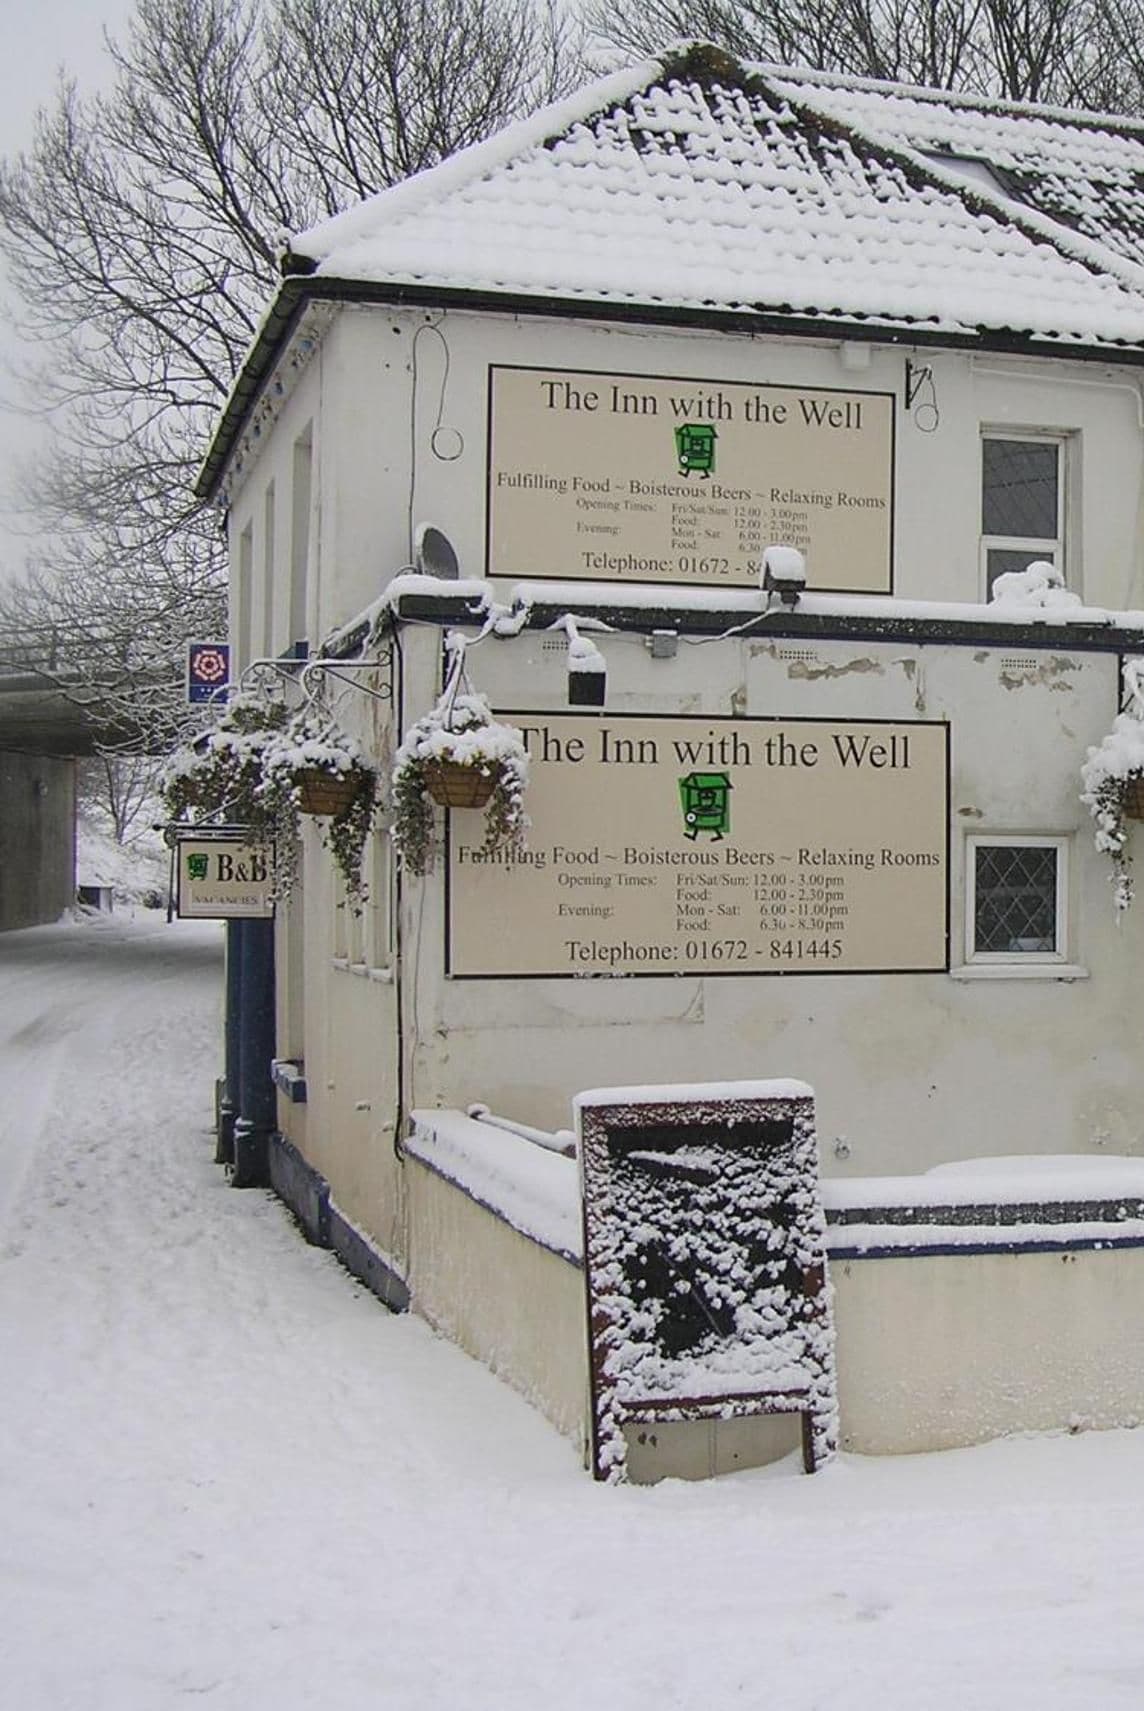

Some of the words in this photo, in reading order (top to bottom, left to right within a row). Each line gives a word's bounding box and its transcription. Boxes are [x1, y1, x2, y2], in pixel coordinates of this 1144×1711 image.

[541, 381, 599, 412] The
[611, 386, 658, 415] Inn
[670, 390, 733, 421] with
[744, 395, 788, 424] the
[798, 399, 863, 430] Well
[497, 472, 567, 492] Fulfilling
[572, 477, 611, 493] Food
[629, 480, 707, 498] Boisterous
[711, 485, 752, 501] Beers
[770, 488, 833, 509] Relaxing
[837, 492, 887, 509] Rooms
[576, 498, 620, 511] Opening
[671, 527, 695, 538] Mon
[582, 551, 673, 574] Telephone:
[678, 557, 730, 575] 01672
[519, 727, 586, 763] The
[598, 729, 658, 764] Inn
[672, 730, 752, 766] with
[765, 733, 819, 767] the
[831, 734, 911, 769] Well
[216, 853, 267, 882] B&B
[552, 847, 600, 865] Food
[624, 847, 719, 866] Boisterous
[725, 848, 775, 866] Beers
[798, 848, 876, 870] Relaxing
[881, 849, 941, 867] Rooms
[558, 872, 612, 888] Opening
[615, 873, 658, 886] Times:
[753, 873, 787, 886] 12.00
[798, 873, 845, 889] 3.00pm
[676, 888, 712, 901] Food:
[753, 888, 787, 901] 12.00
[798, 888, 844, 903] 2.30pm
[558, 903, 615, 919] Evening:
[676, 904, 705, 916] Mon
[717, 903, 741, 917] Sat:
[759, 904, 787, 916] 6.00
[798, 903, 849, 918] 11.00pm
[676, 918, 711, 931] Food:
[759, 918, 787, 930] 6.30
[798, 918, 845, 933] 8.30pm
[565, 941, 678, 966] Telephone:
[685, 940, 748, 960] 01672
[769, 939, 843, 960] 841445
